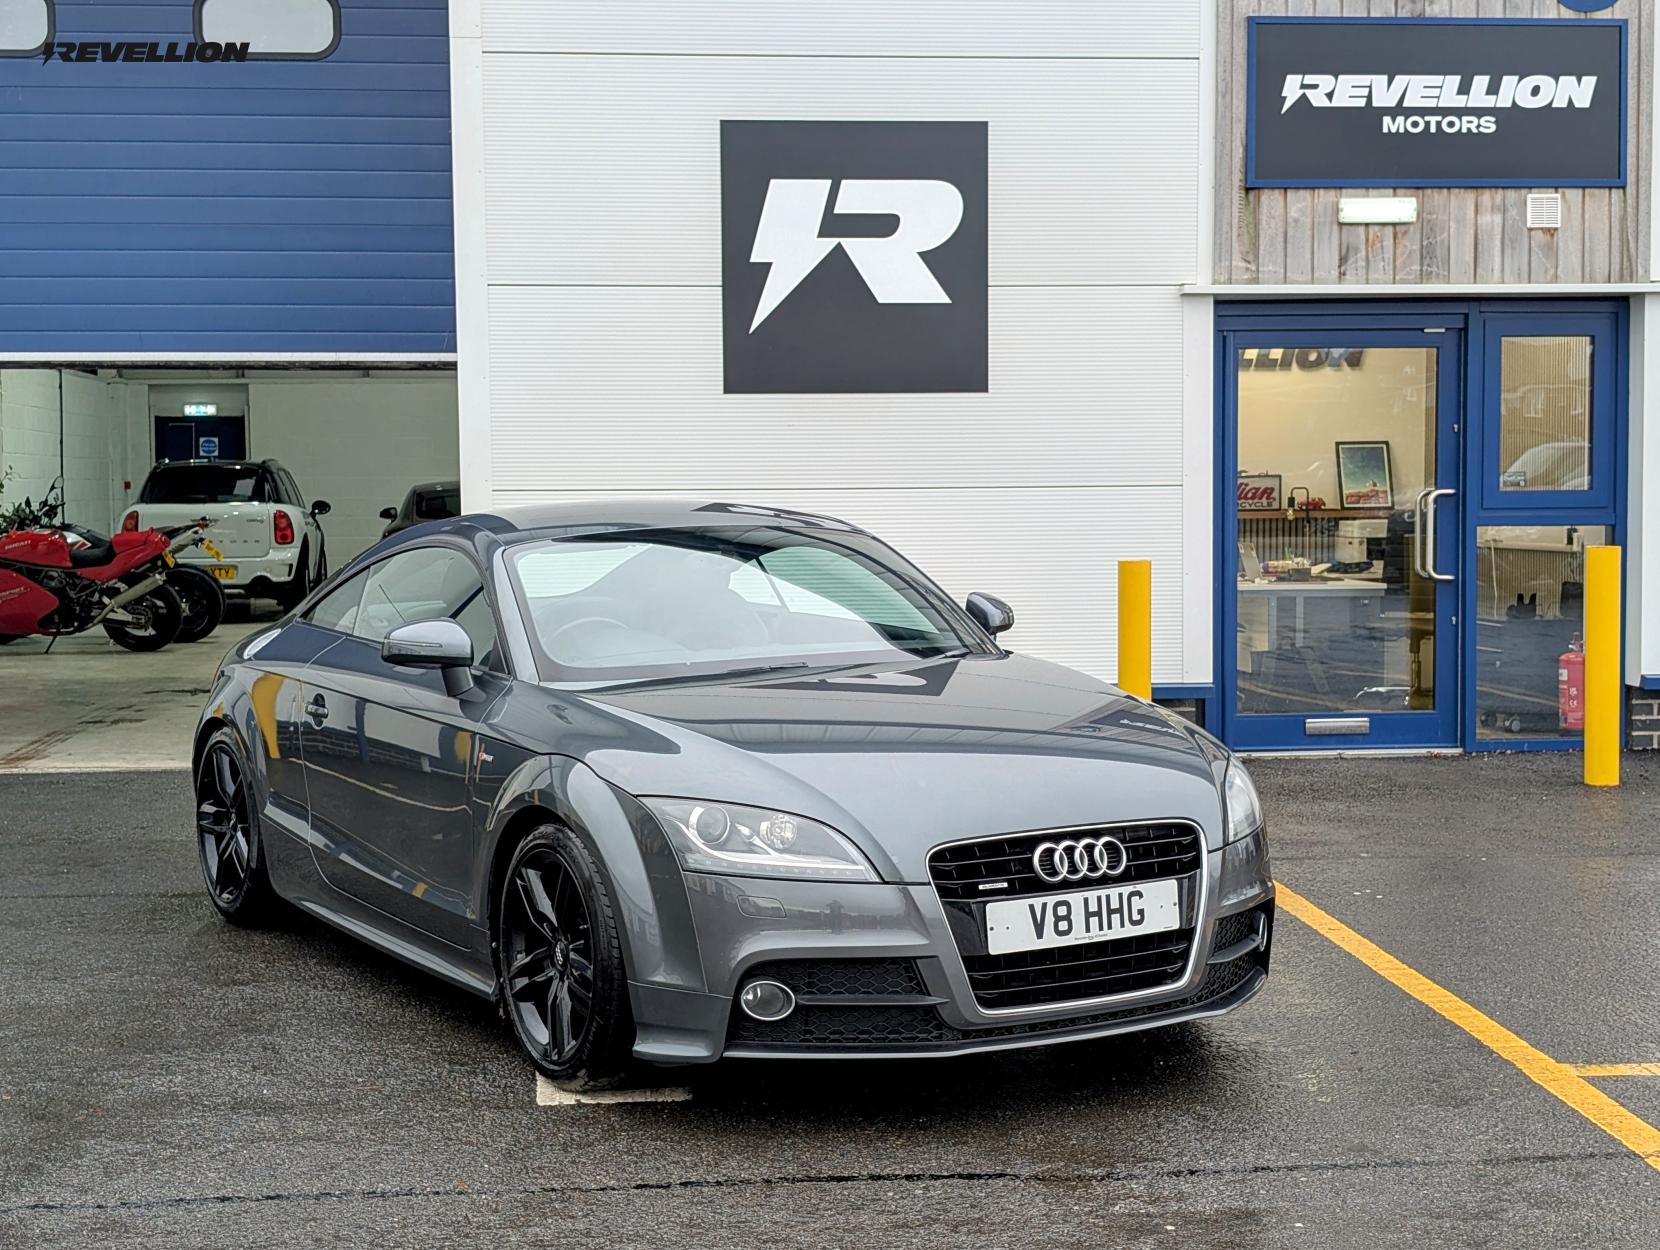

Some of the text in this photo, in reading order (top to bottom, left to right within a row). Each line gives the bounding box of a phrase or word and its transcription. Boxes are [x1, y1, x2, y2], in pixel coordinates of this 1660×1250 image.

[1281, 74, 1597, 114] REVELLION
[1382, 115, 1497, 133] MOTORS
[1028, 890, 1145, 940] V8 HHG
